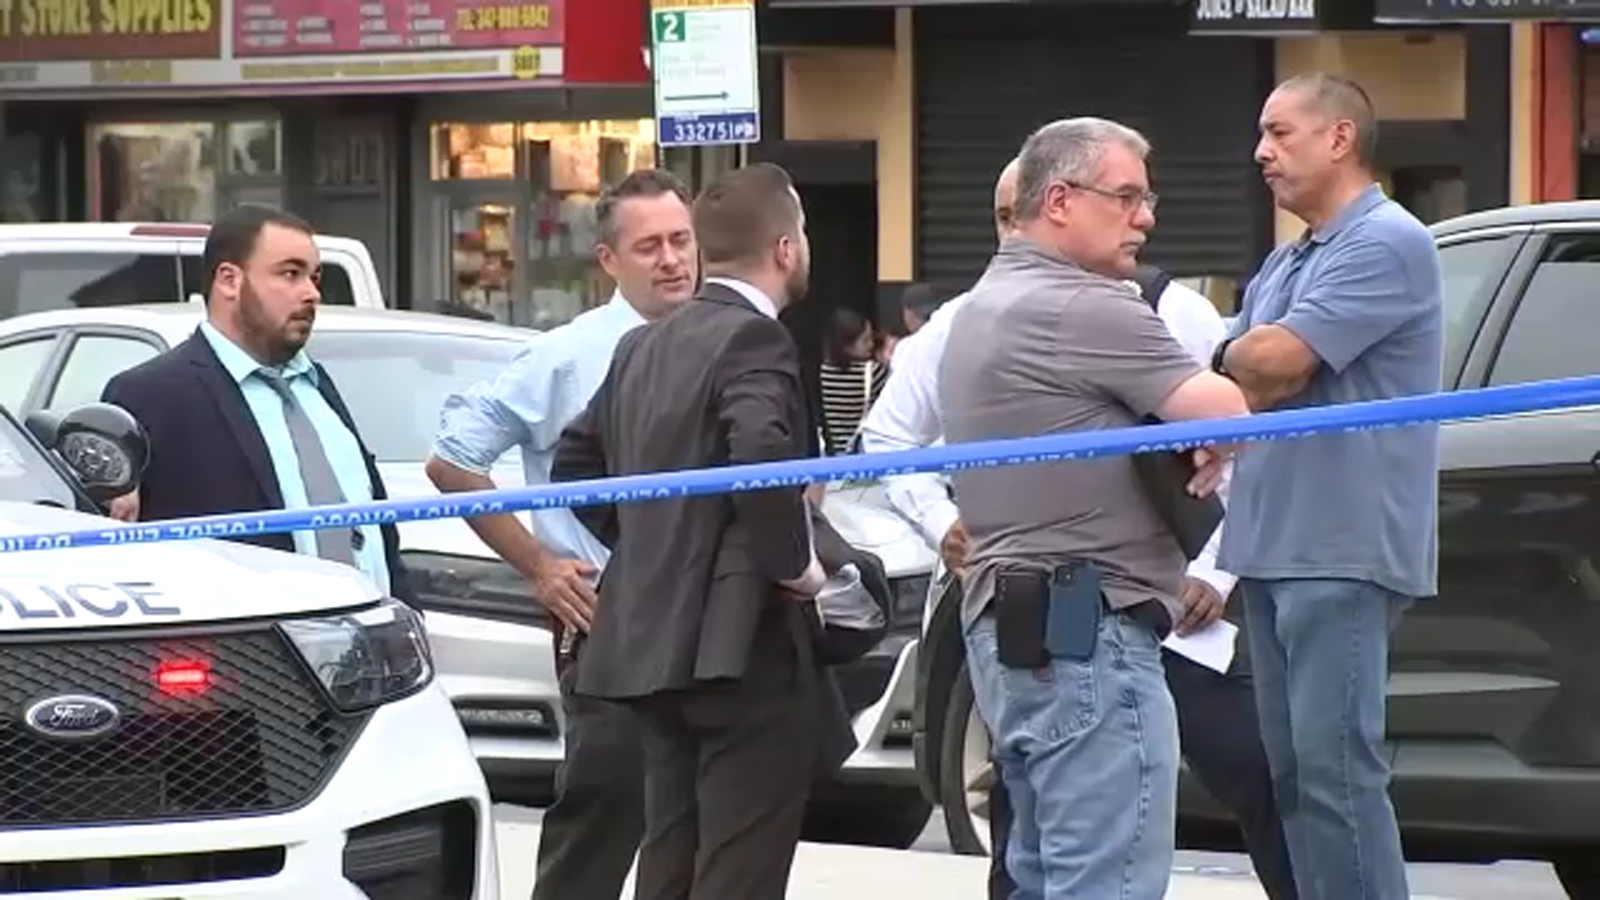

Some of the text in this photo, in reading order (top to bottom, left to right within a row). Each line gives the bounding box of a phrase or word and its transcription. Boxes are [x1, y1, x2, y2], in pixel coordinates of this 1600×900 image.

[21, 0, 91, 36] STORE
[100, 0, 212, 34] SUPPLIES
[663, 13, 679, 41] 2
[0, 581, 182, 619] LICE
[49, 703, 99, 728] Ford
